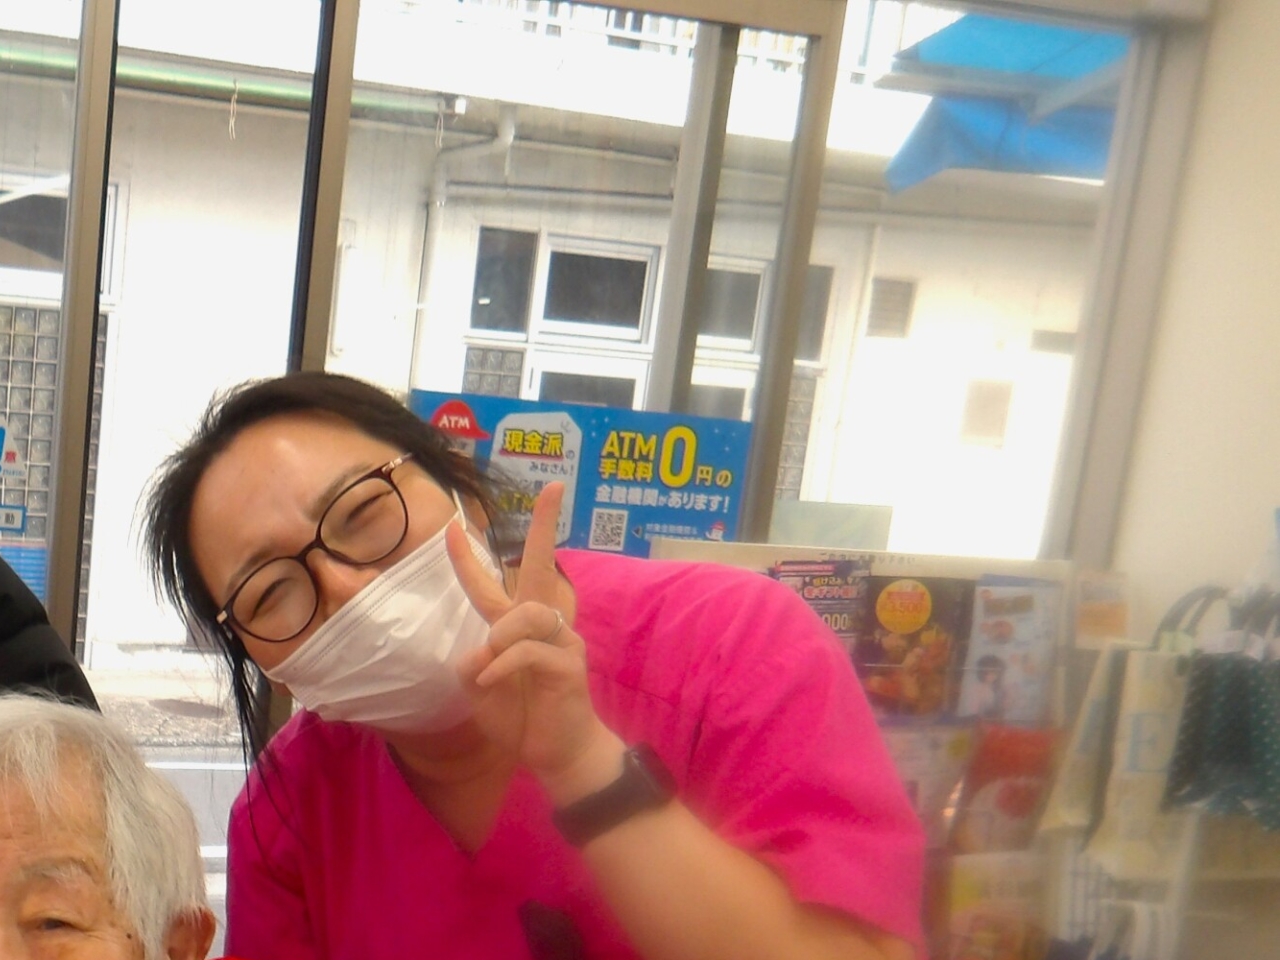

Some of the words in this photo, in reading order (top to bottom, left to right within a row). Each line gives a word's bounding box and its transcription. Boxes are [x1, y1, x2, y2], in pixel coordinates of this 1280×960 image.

[438, 415, 470, 430] ATM
[601, 430, 658, 460] ATM
[599, 457, 654, 483] 手数料
[595, 484, 730, 513] 金融機関があります!
